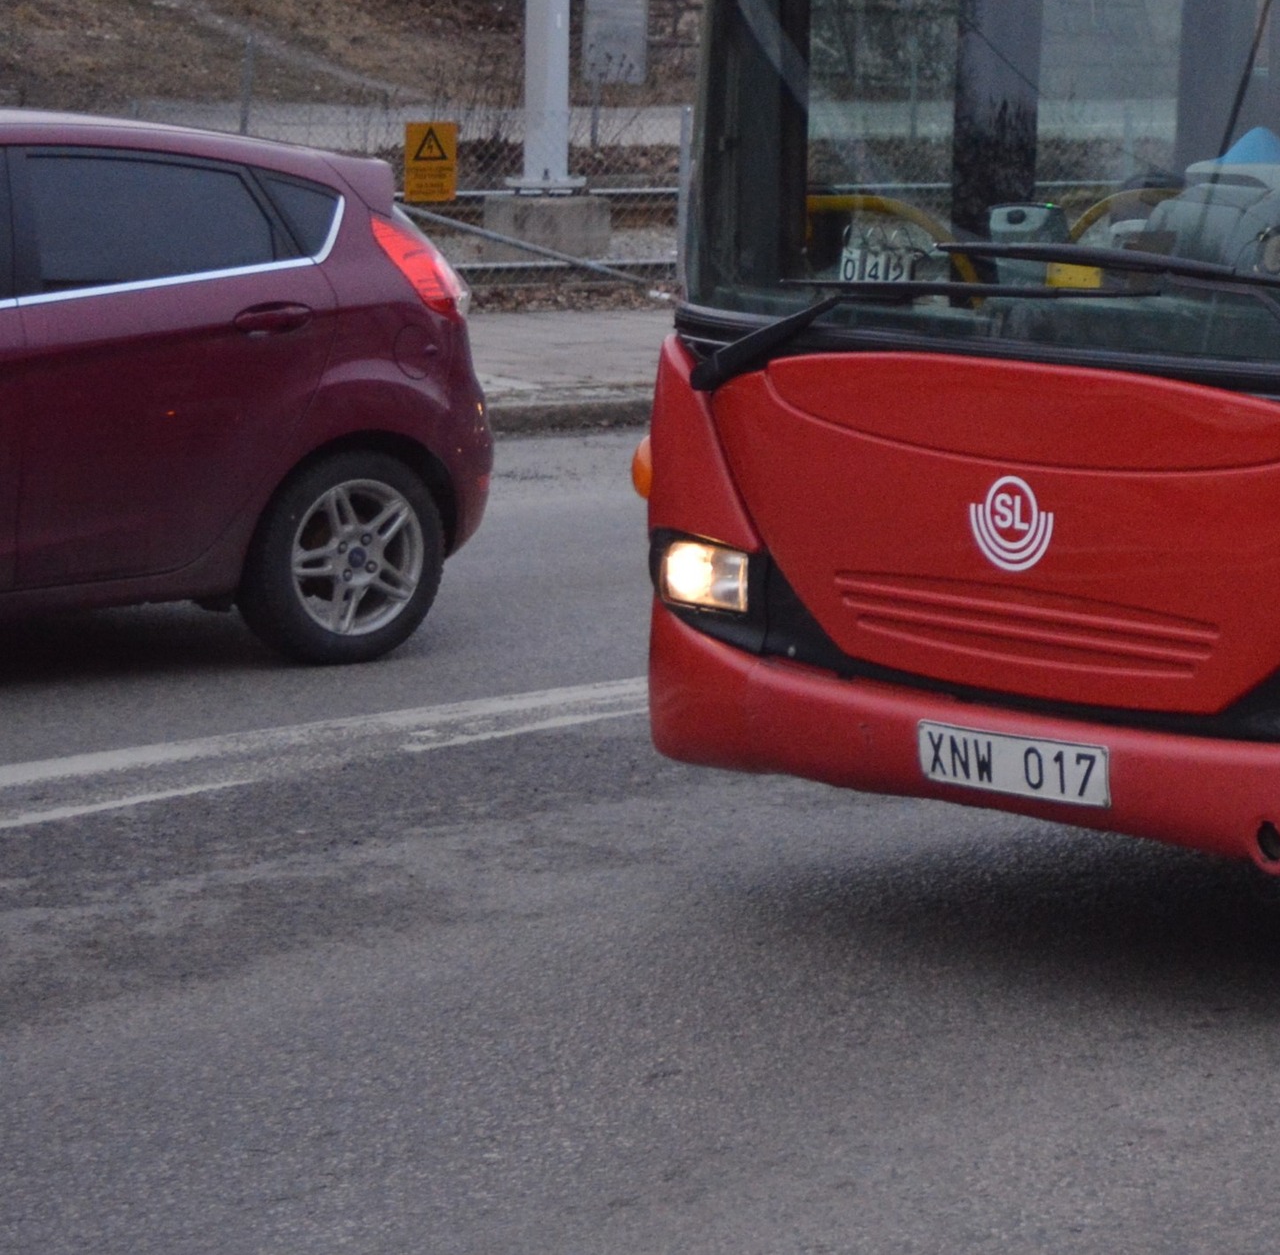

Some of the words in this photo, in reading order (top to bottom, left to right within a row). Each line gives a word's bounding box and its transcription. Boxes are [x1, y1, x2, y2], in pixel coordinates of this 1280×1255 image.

[994, 493, 1029, 530] SL
[928, 731, 992, 783] XNW
[1024, 746, 1096, 796] 017
